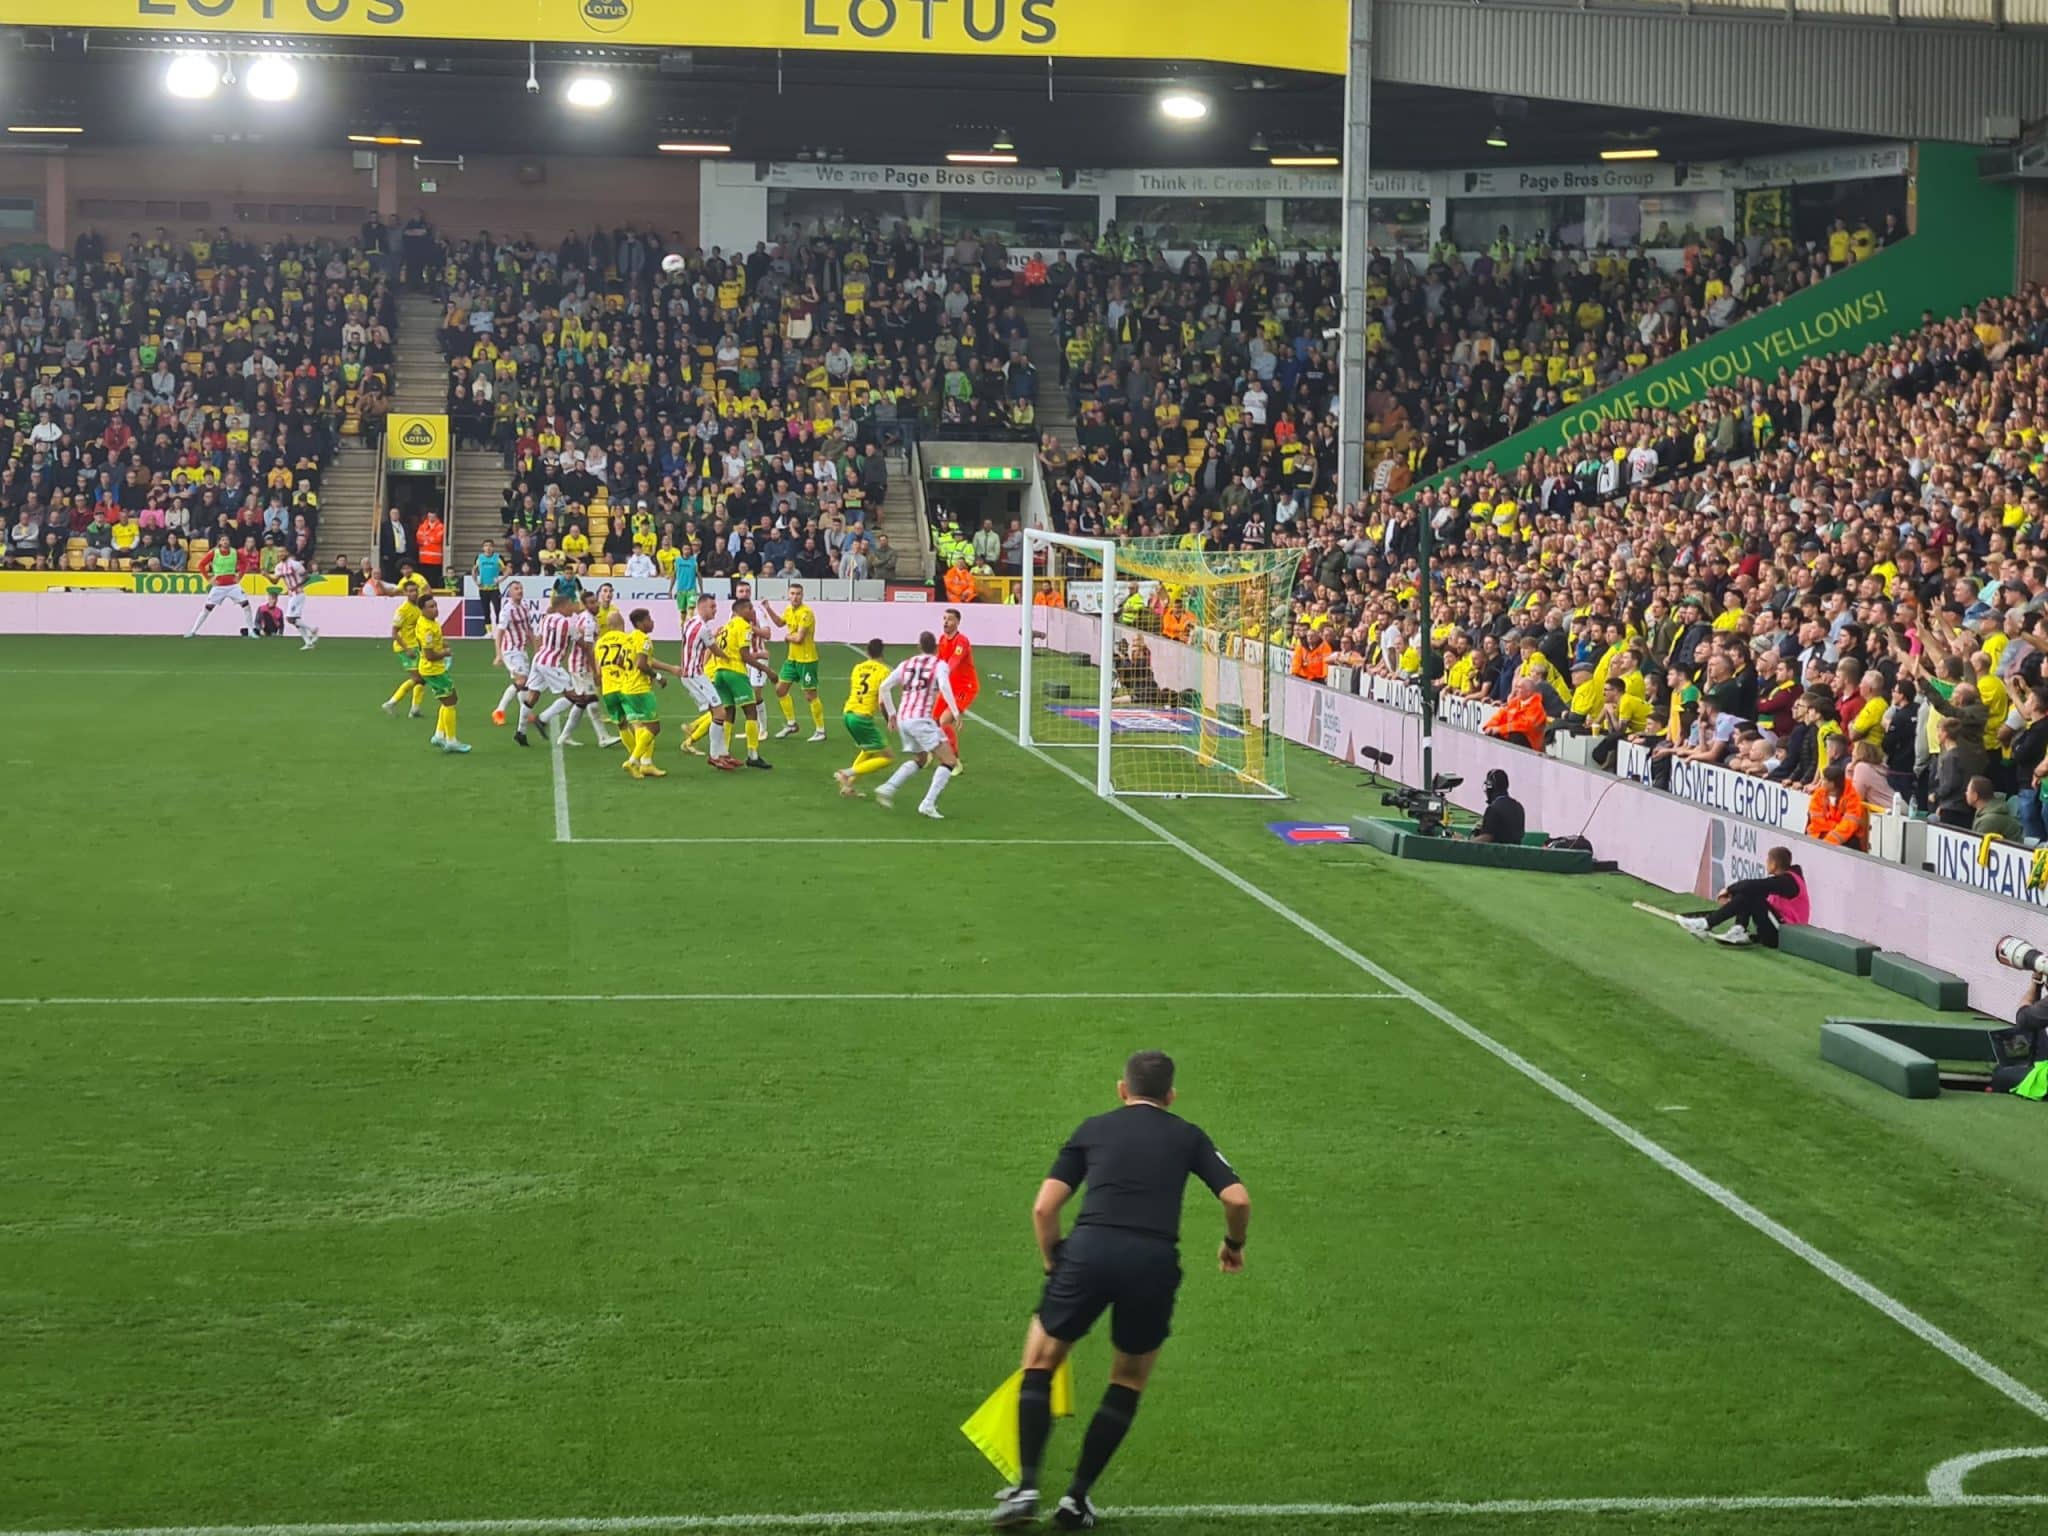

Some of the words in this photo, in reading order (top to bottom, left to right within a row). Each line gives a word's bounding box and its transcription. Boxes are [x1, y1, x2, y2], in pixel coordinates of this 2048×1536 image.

[587, 5, 625, 16] LOTUS
[804, 0, 1057, 44] LOTUS
[815, 167, 842, 182] We
[848, 171, 878, 182] are
[885, 168, 929, 187] Page
[935, 169, 974, 185] Bros
[981, 170, 1036, 189] Group
[1140, 175, 1186, 191] Think
[1519, 172, 1558, 192] Page
[1563, 171, 1598, 187] Bros
[1603, 169, 1653, 187] Group
[1647, 371, 1692, 409] ON
[1691, 343, 1752, 391] YOU
[1753, 290, 1889, 364] YELLOWS!
[858, 672, 871, 694] 3
[1627, 749, 1651, 787] ALA
[1669, 761, 1729, 812] OSWELL
[1734, 776, 1789, 827] GROUP
